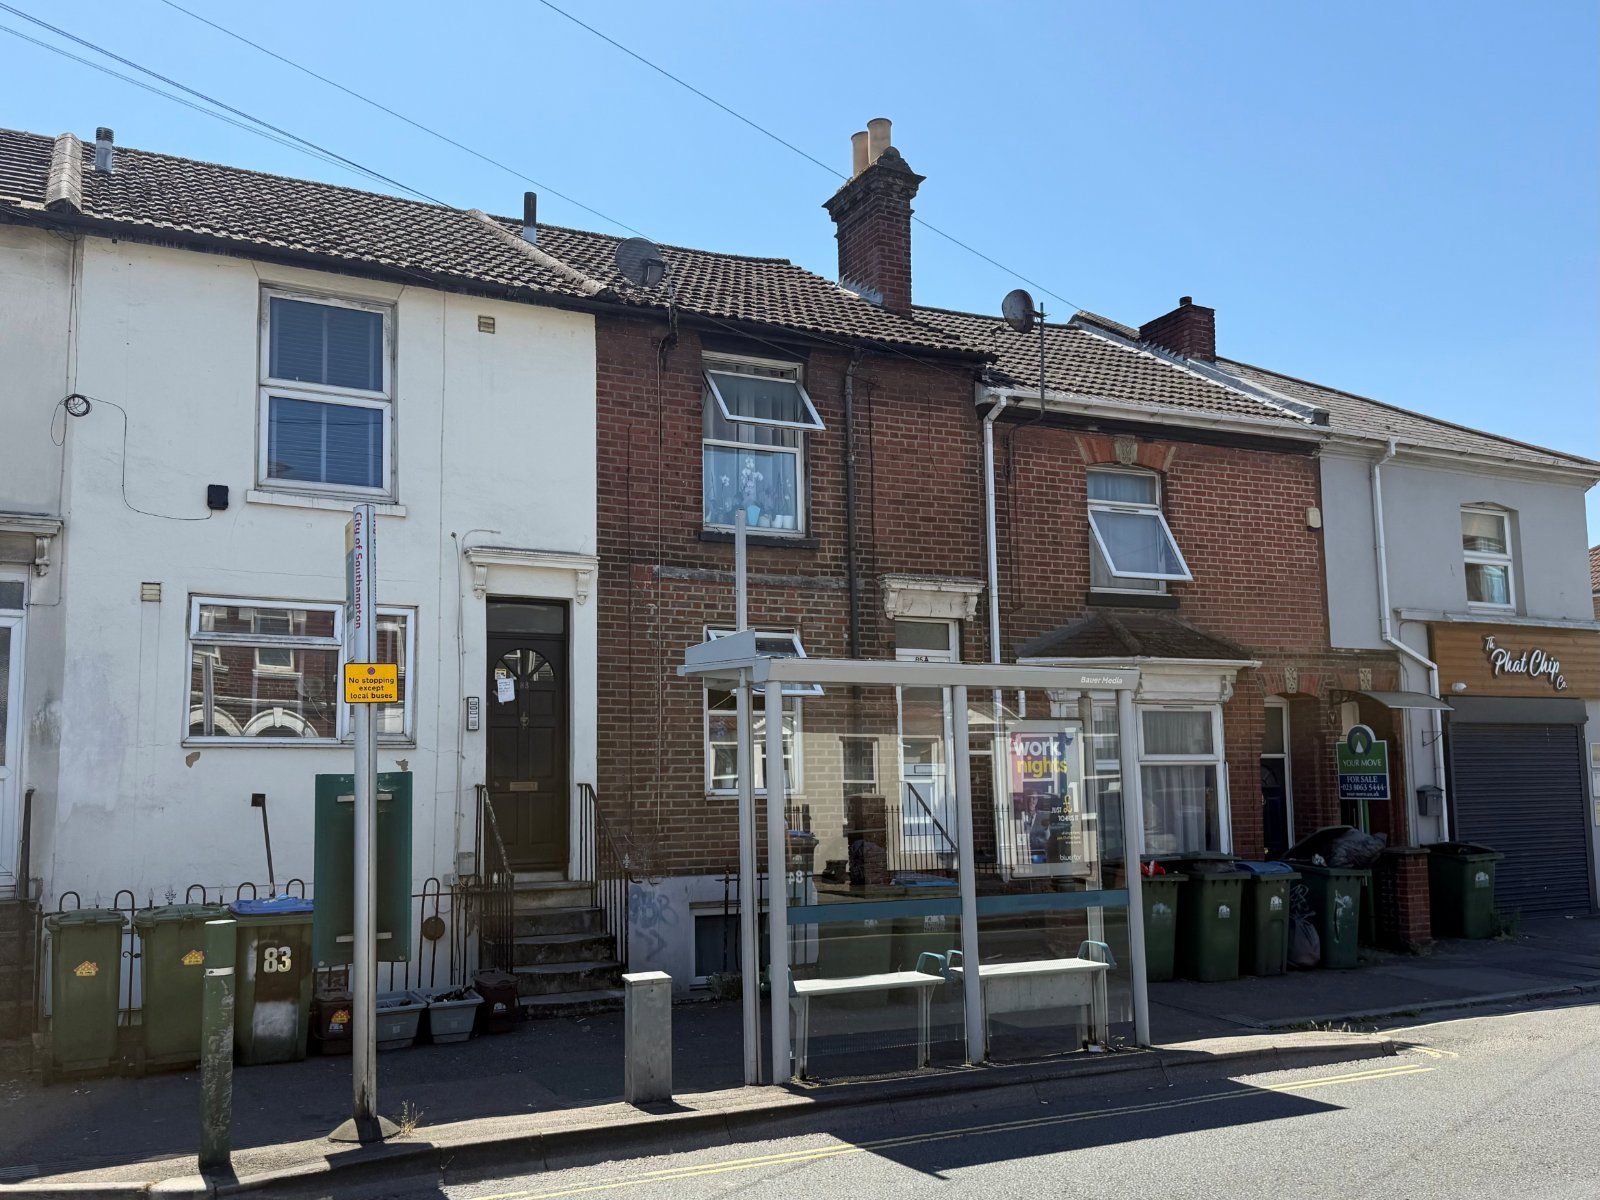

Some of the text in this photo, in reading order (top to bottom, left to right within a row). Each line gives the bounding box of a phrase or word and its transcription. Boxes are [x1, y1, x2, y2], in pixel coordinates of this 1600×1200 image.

[354, 512, 363, 629] City of Southampton
[1491, 648, 1560, 682] Phat Chip
[1081, 676, 1123, 684] Bauer Media
[1556, 675, 1568, 690] Co.
[1014, 741, 1061, 756] work
[1016, 755, 1068, 778] nights
[1342, 758, 1382, 767] YOUR MOVE
[1347, 775, 1378, 783] FOR SALE
[263, 946, 292, 973] 83
